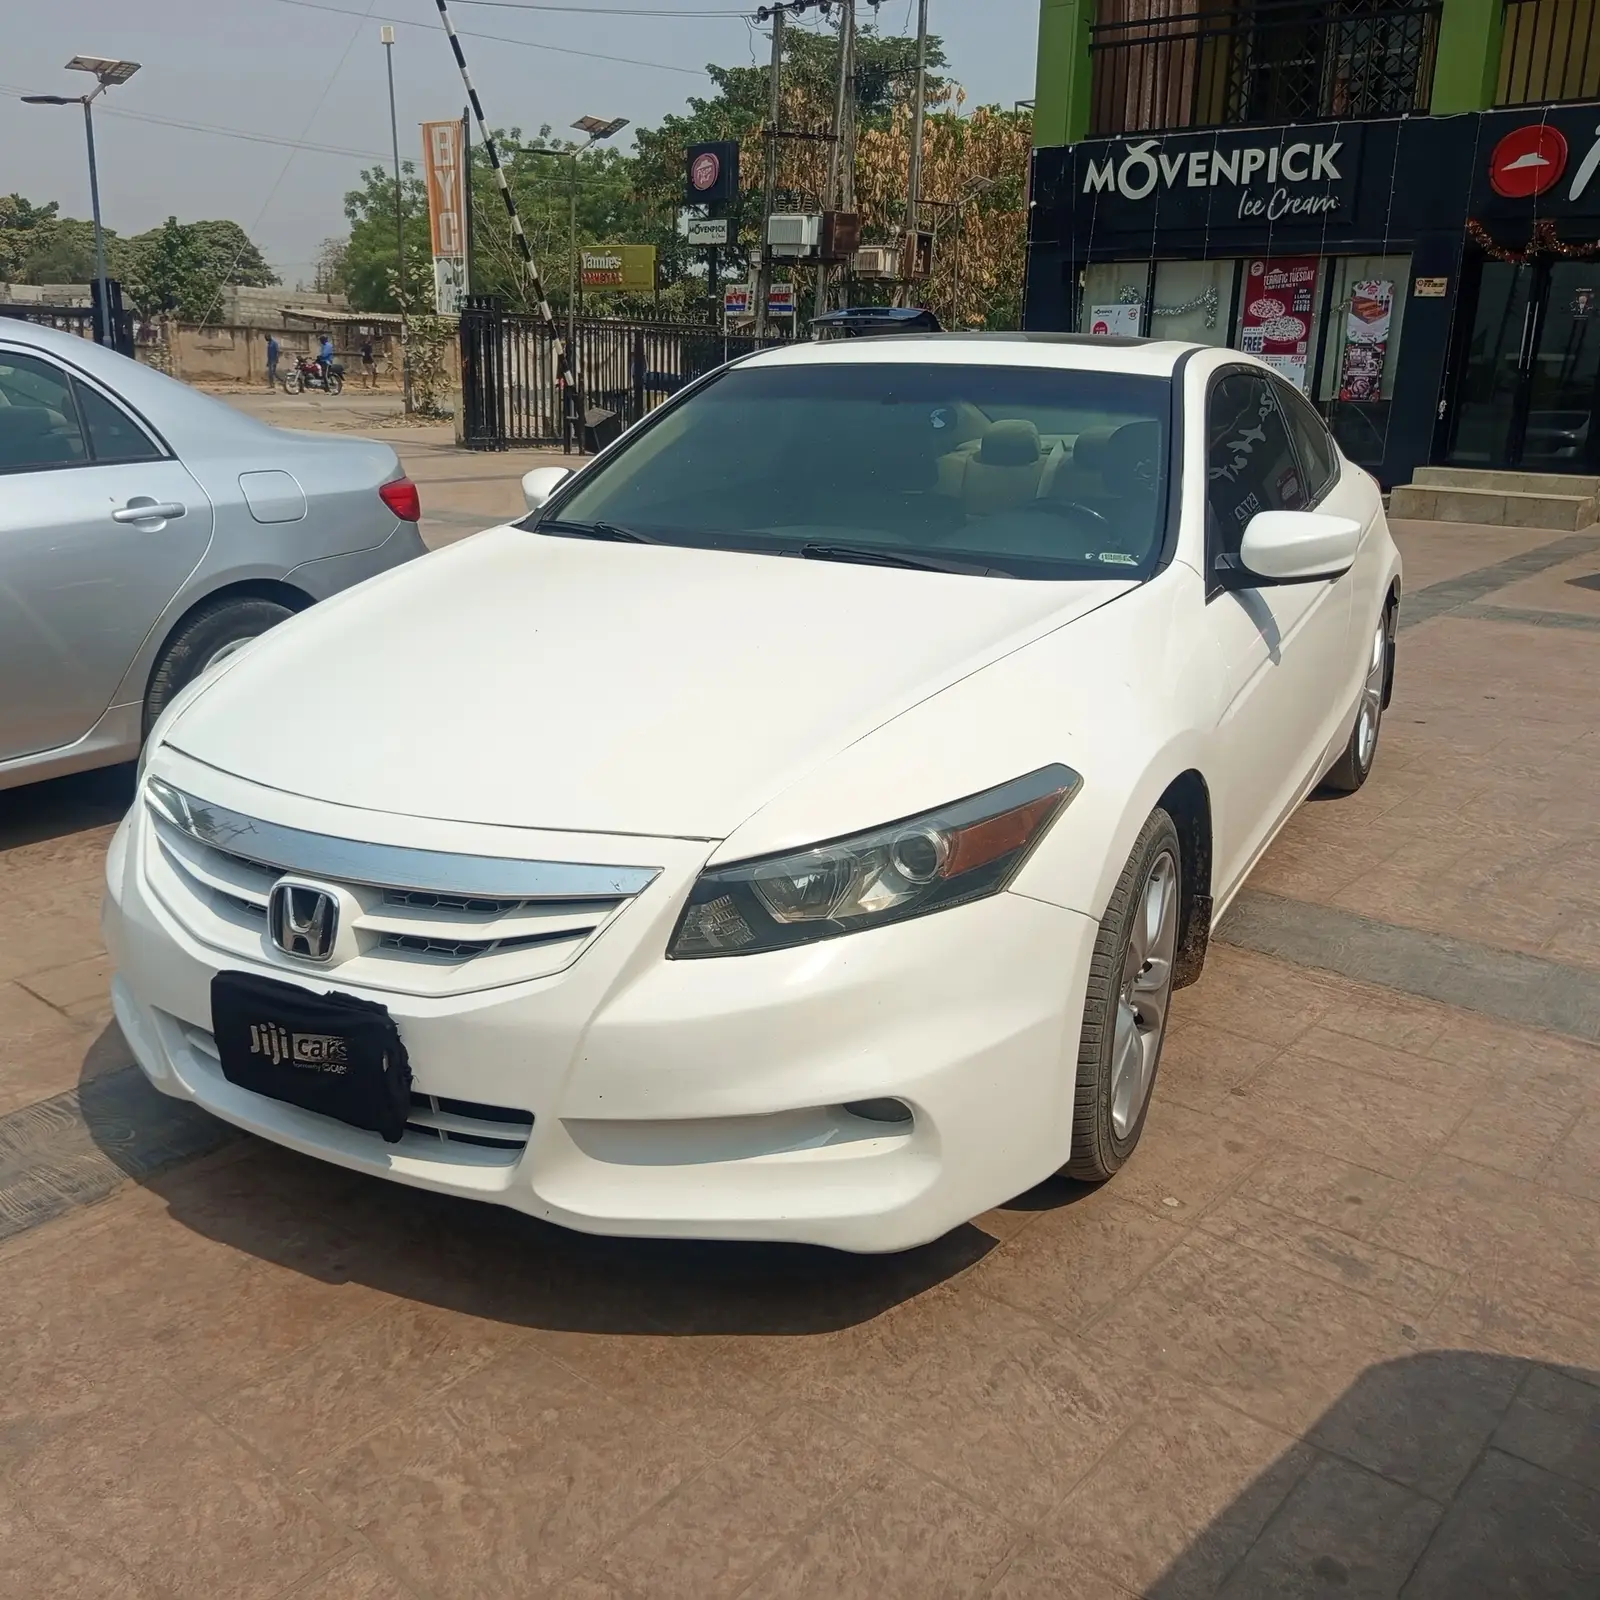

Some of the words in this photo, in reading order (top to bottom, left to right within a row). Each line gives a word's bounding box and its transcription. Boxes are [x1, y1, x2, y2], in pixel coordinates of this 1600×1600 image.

[1238, 188, 1265, 219] Ice
[1267, 188, 1339, 221] Cream
[1264, 273, 1288, 287] TERRIFIC
[1289, 270, 1315, 283] TUESDAY
[1243, 336, 1262, 352] FREE
[250, 1021, 289, 1065] Jiji
[297, 1038, 348, 1062] cars
